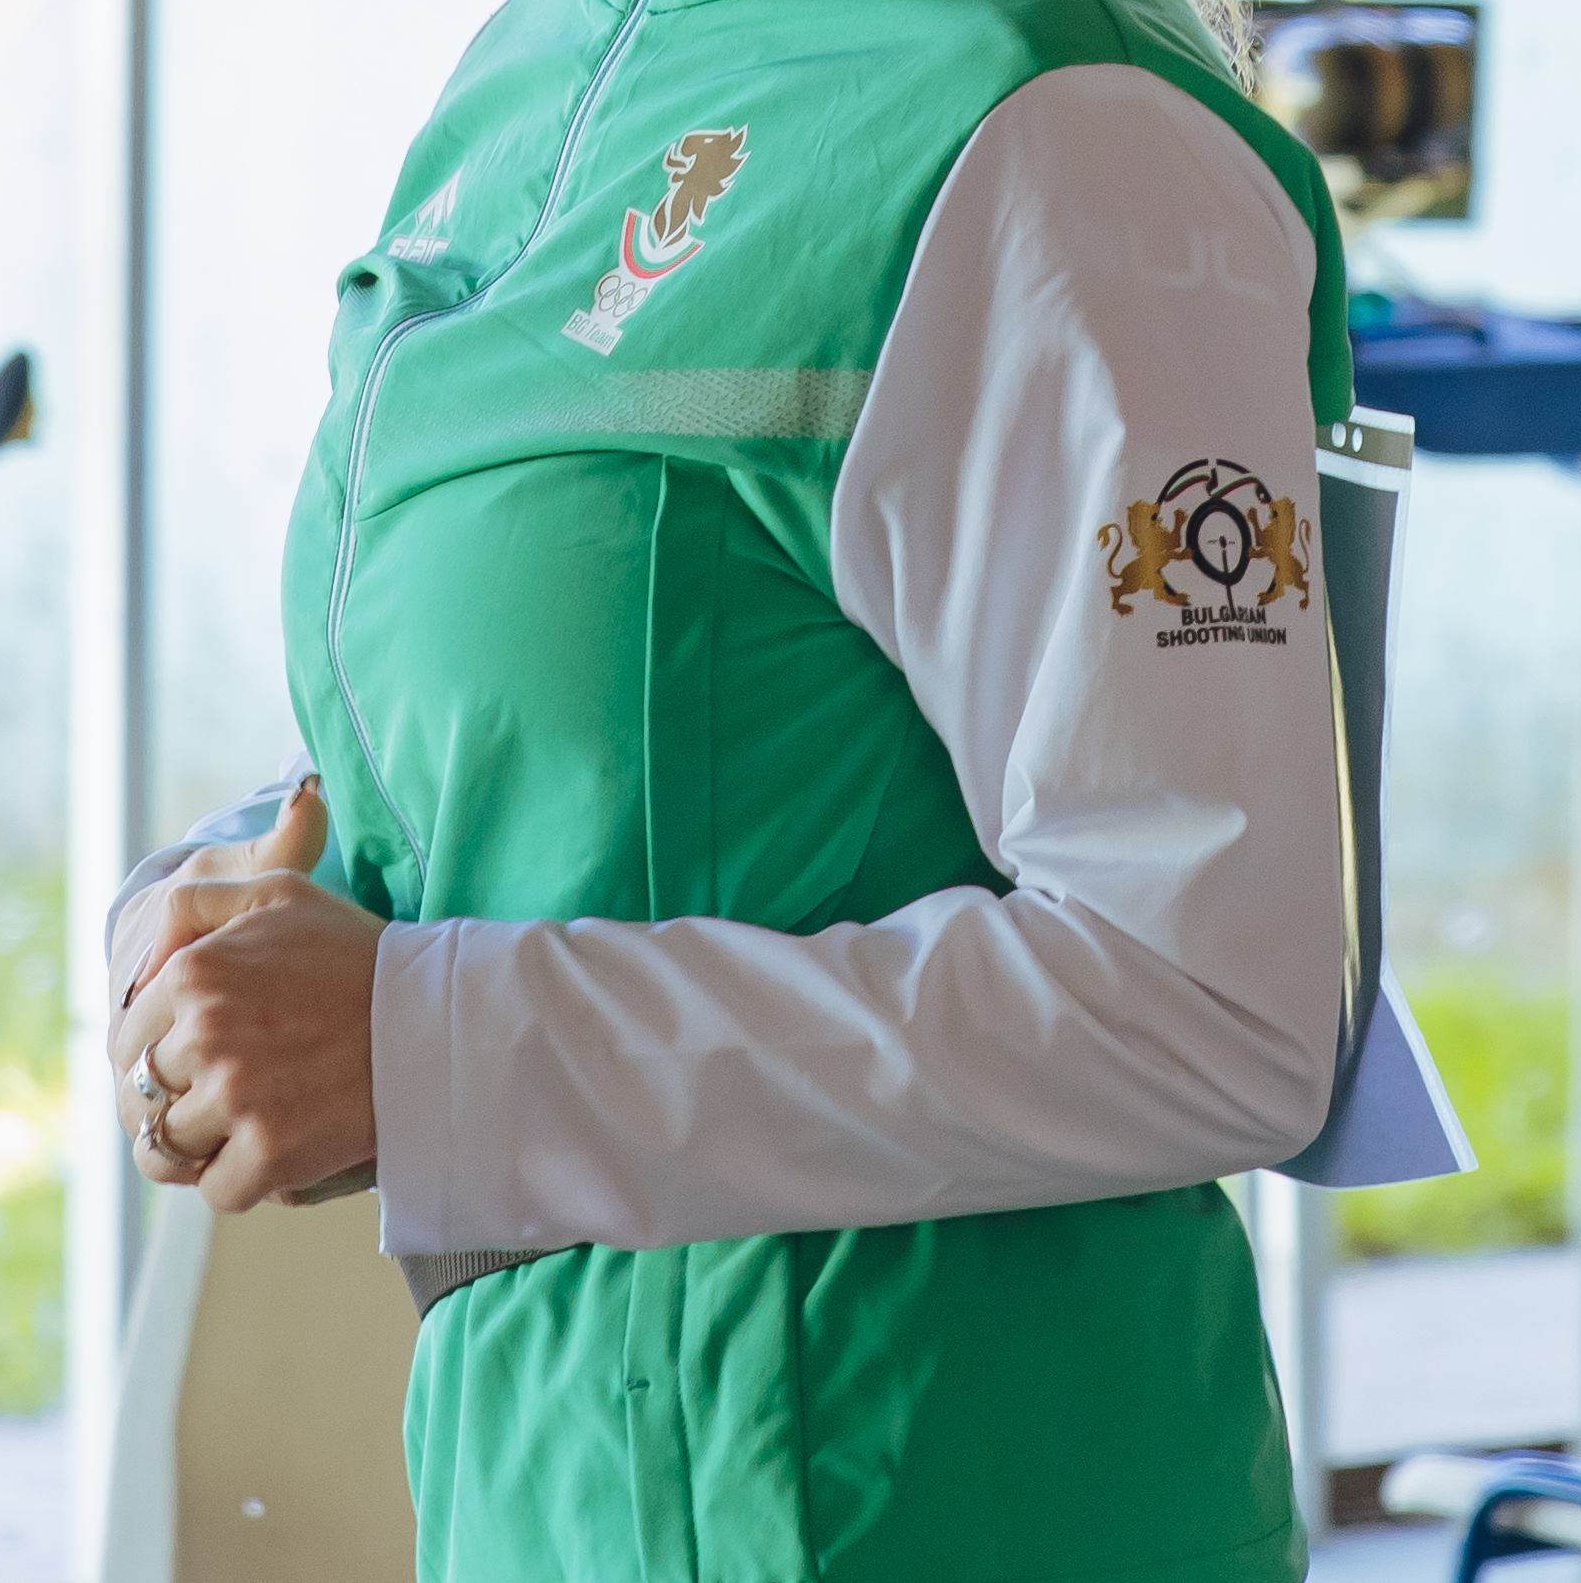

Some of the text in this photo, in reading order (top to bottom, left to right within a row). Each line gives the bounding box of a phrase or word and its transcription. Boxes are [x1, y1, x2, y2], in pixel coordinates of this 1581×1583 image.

[567, 314, 616, 349] BG Team
[1181, 605, 1266, 626] BULGARIAN
[1156, 626, 1287, 648] SHOOTING UNION
